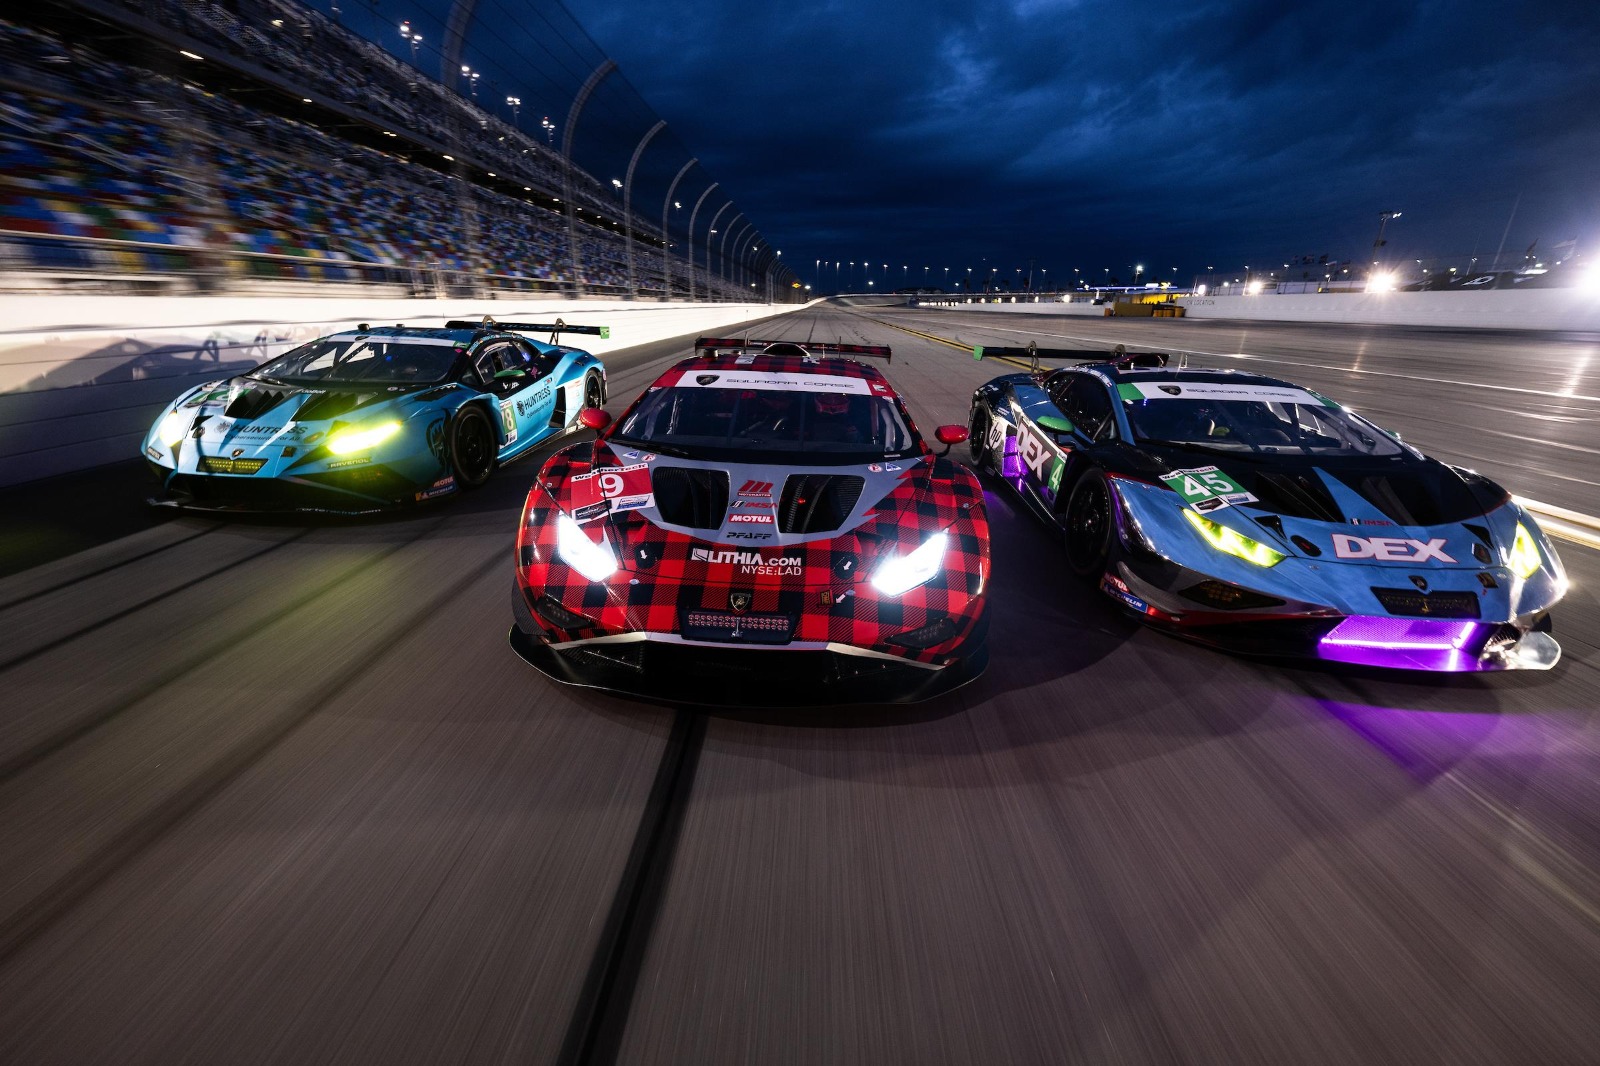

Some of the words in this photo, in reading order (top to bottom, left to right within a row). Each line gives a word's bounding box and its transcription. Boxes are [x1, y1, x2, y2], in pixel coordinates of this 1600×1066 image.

[524, 386, 551, 410] HUNTRESS
[231, 425, 308, 434] HUNTRSS
[1017, 421, 1051, 482] DEX
[597, 473, 625, 498] 9
[1184, 473, 1234, 497] 45
[730, 515, 772, 523] MOTUL
[727, 532, 772, 540] PFAFF
[1331, 533, 1459, 564] DEX
[741, 565, 802, 576] NYSE:LAD
